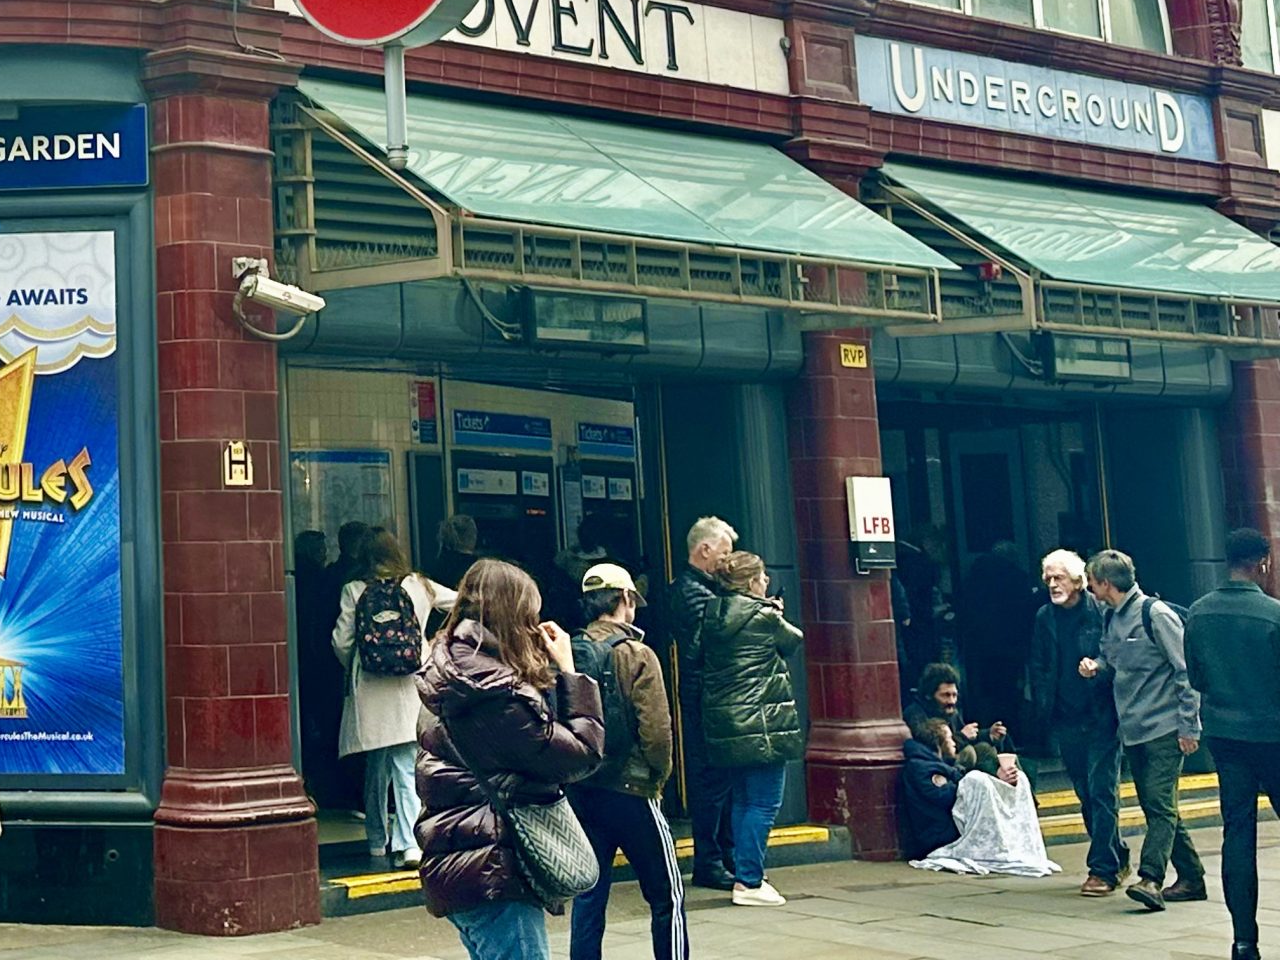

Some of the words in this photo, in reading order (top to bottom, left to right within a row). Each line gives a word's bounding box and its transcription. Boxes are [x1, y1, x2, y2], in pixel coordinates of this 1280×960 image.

[6, 287, 89, 307] AWAITS
[843, 347, 865, 363] RVP
[456, 412, 484, 431] Tickets
[228, 445, 249, 480] H
[22, 510, 65, 524] MUSICAL
[863, 517, 891, 534] LFB
